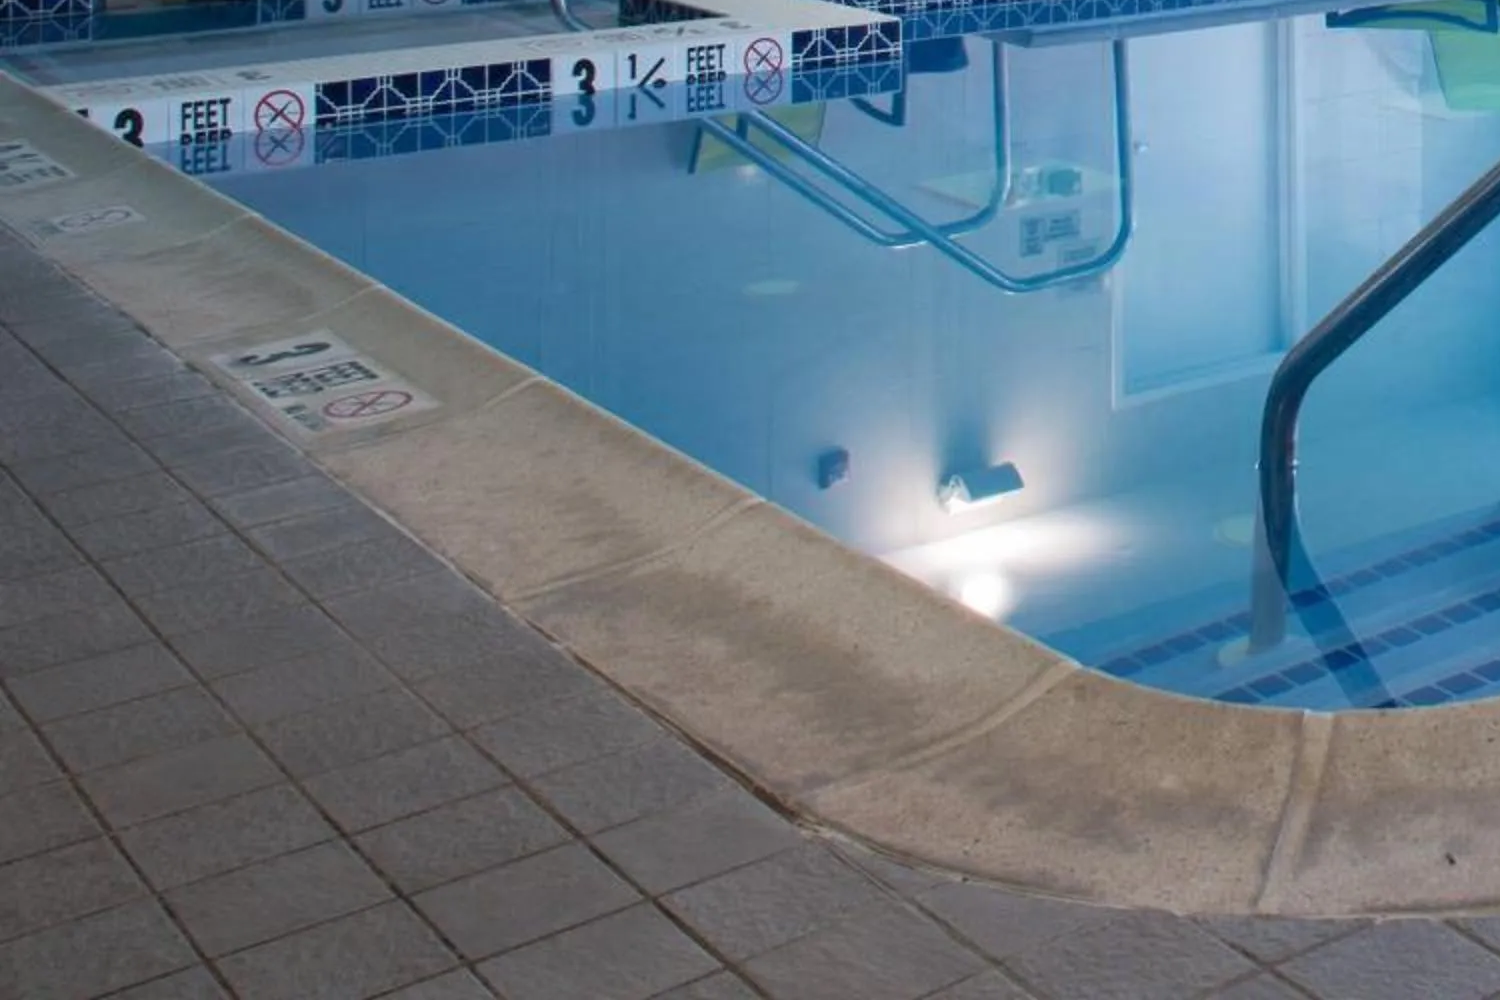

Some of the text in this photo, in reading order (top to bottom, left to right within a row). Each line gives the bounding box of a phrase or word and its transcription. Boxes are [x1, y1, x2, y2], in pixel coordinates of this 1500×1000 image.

[687, 44, 726, 75] FEET
[114, 97, 232, 147] 3 FEET
